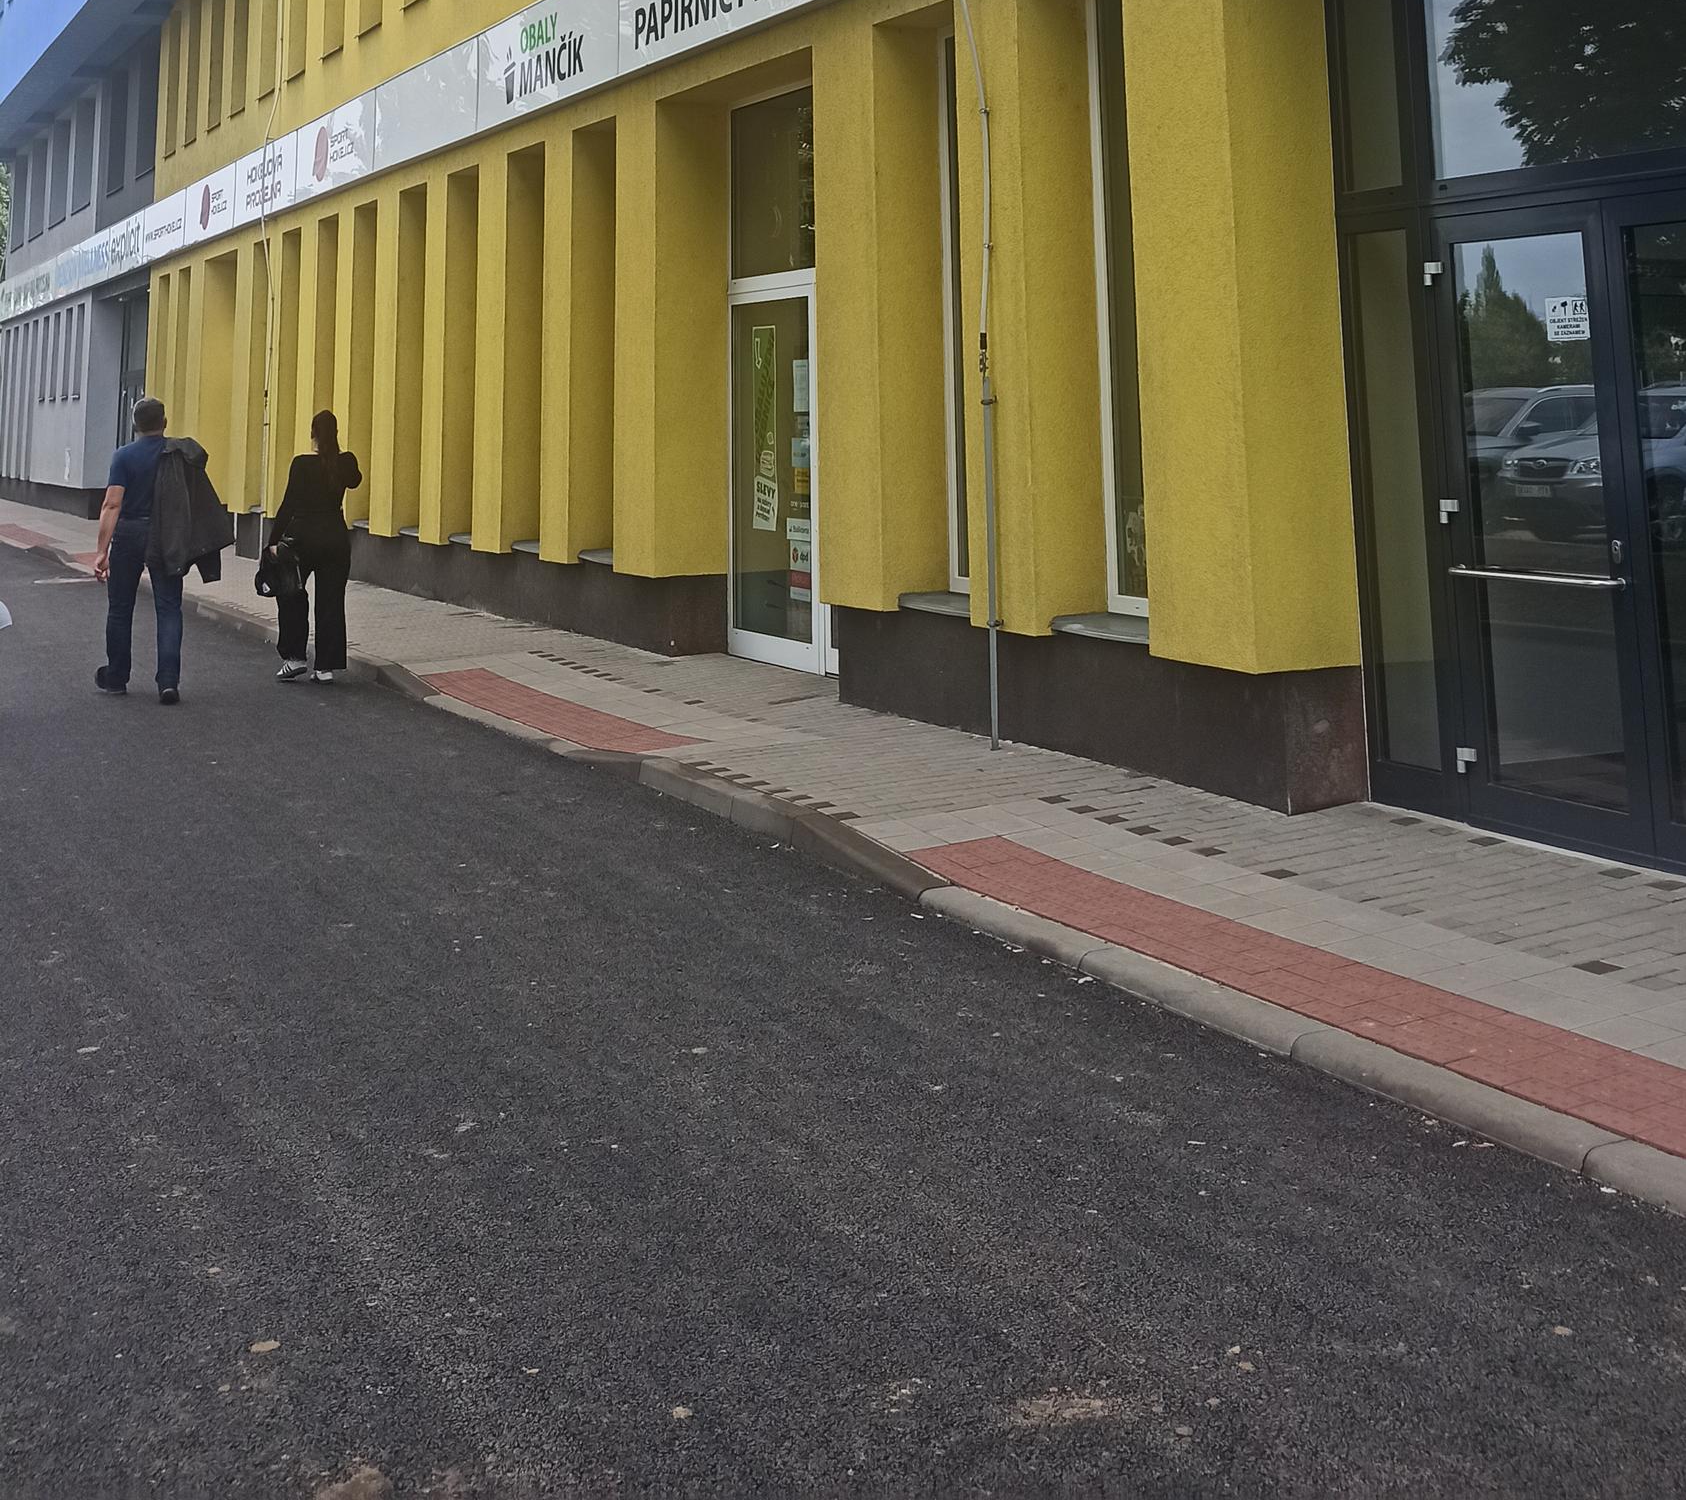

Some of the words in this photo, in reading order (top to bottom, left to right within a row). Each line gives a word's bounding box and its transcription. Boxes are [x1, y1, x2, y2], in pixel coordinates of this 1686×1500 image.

[519, 11, 558, 55] OBALY
[519, 30, 584, 98] MANČÍK
[330, 128, 349, 149] SPORT
[110, 216, 141, 270] explicit
[756, 480, 776, 500] SLEVY
